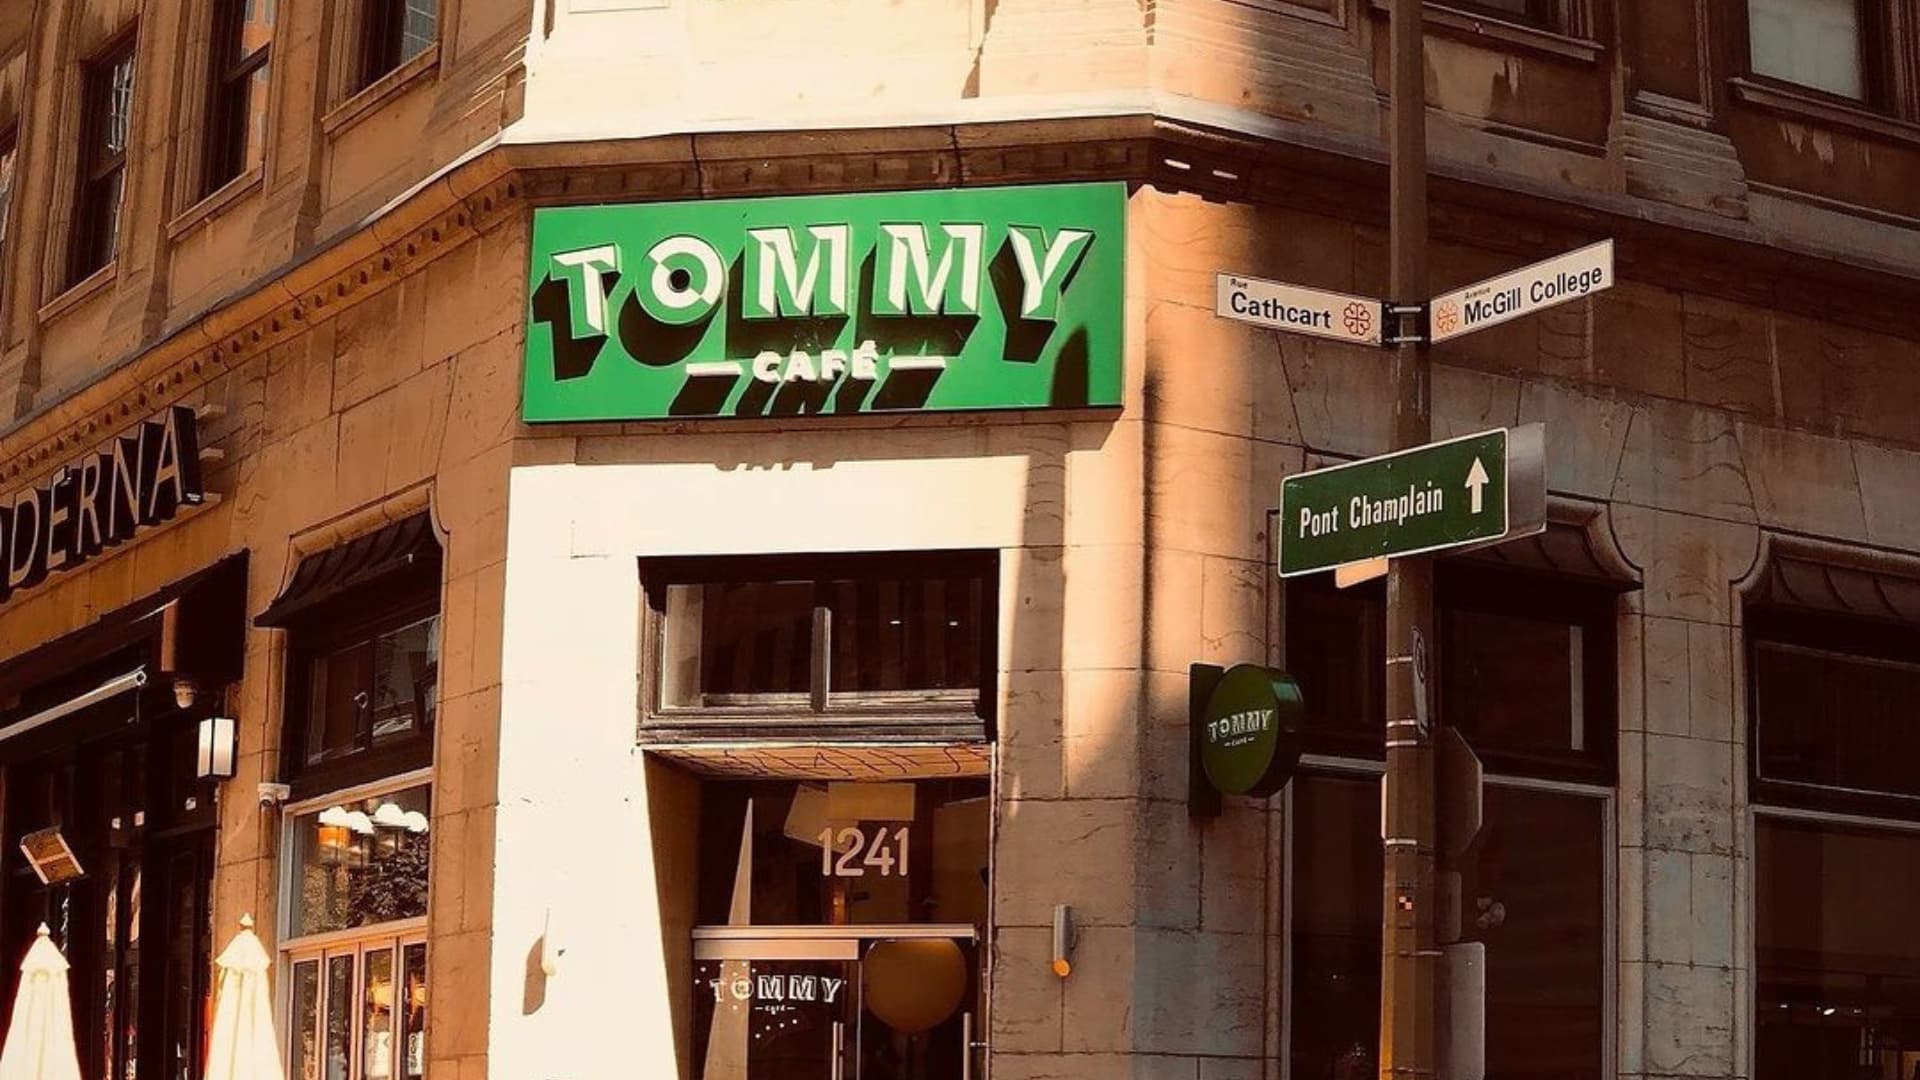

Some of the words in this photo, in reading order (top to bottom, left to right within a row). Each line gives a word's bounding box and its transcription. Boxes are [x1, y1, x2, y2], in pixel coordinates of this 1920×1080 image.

[551, 222, 1095, 340] TOMMY
[1230, 278, 1248, 290] Rue
[1464, 288, 1522, 326] McGill
[1531, 265, 1603, 303] College
[1230, 291, 1331, 330] Cathcart
[753, 340, 879, 382] CAFÉ
[1300, 507, 1339, 539] Pont
[1350, 480, 1443, 529] Champlain
[1208, 709, 1273, 743] TOMMY
[818, 827, 909, 877] 1241
[709, 974, 842, 1003] TOMMY
